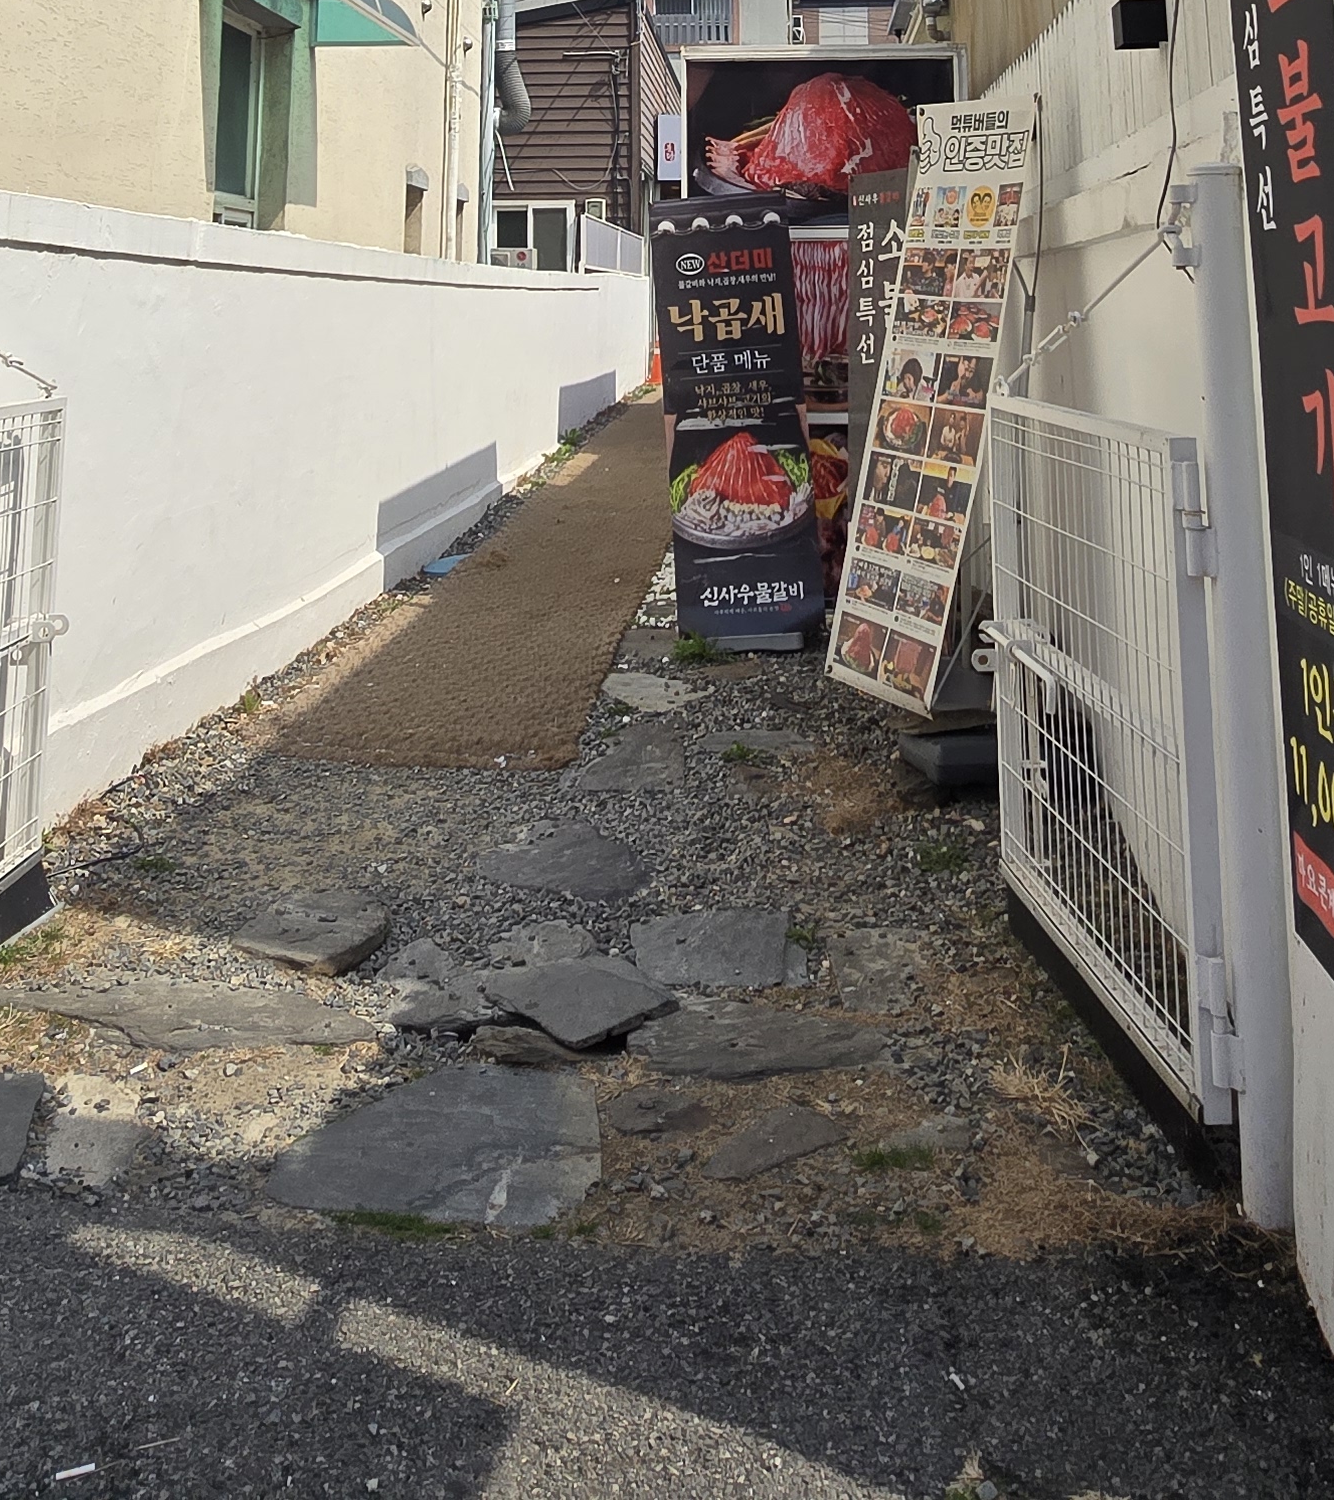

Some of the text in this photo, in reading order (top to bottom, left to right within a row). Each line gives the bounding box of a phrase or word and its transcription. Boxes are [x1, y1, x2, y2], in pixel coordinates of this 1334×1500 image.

[951, 110, 1009, 133] 먹튜버들의
[943, 130, 1030, 172] 인증맛집
[680, 258, 702, 271] NEW
[707, 248, 773, 273] 산더미
[856, 221, 876, 365] 점심특선
[667, 293, 786, 342] 낙곱새
[691, 349, 771, 374] 단품 메뉴
[1300, 553, 1313, 586] 1인
[700, 581, 805, 607] 신사우물갈비
